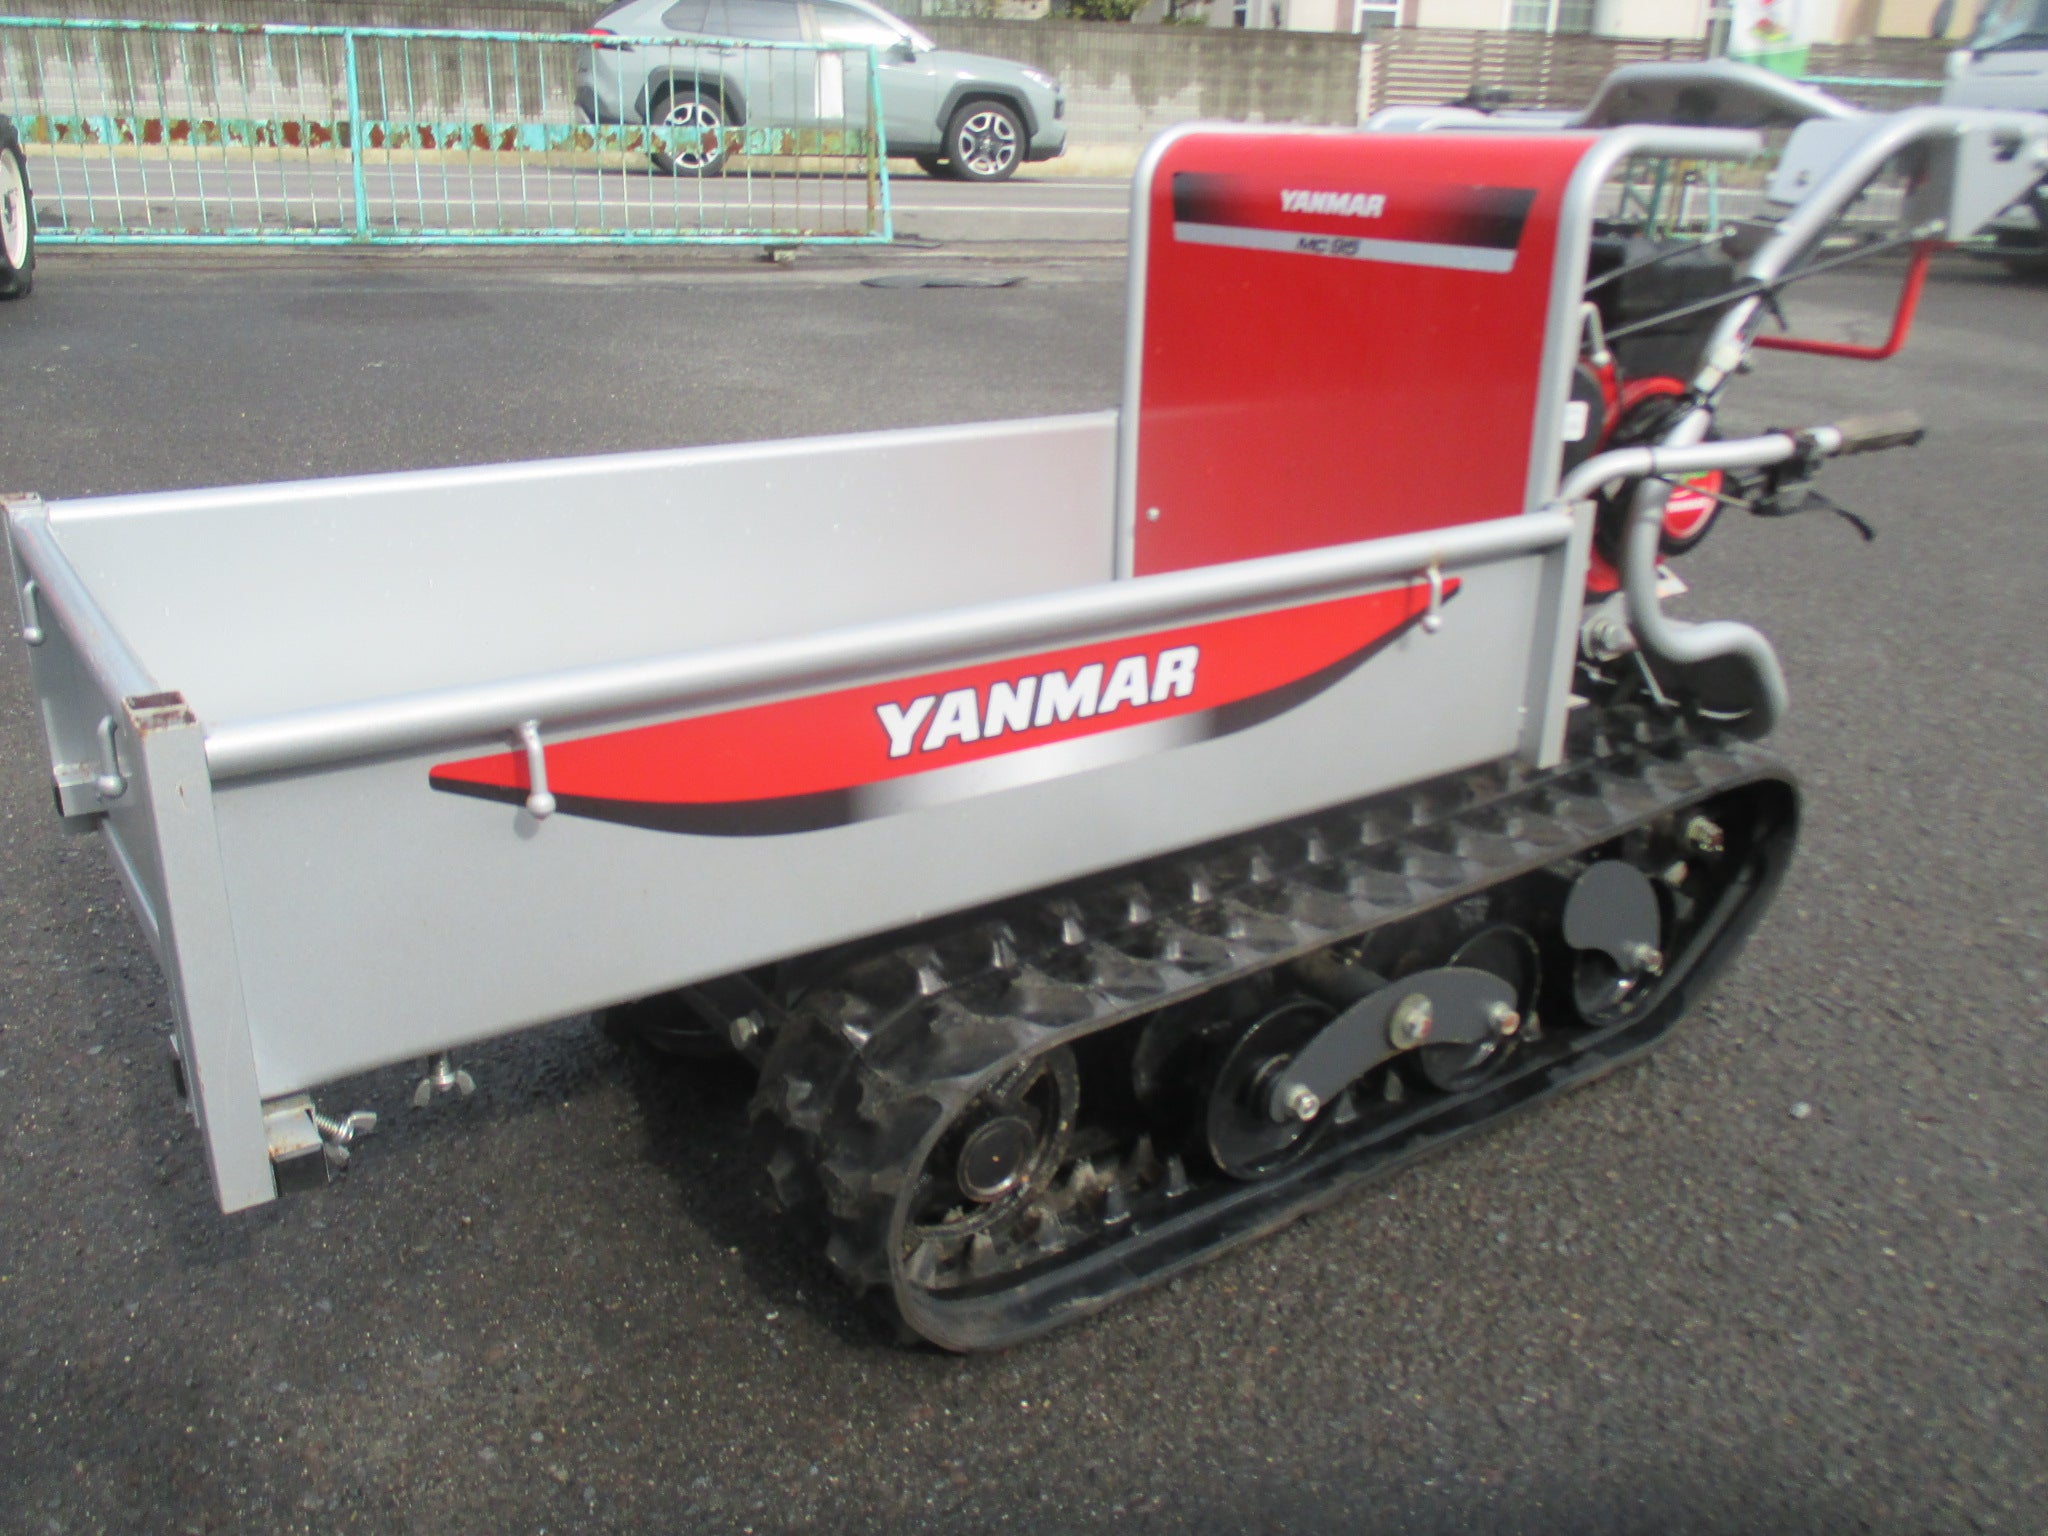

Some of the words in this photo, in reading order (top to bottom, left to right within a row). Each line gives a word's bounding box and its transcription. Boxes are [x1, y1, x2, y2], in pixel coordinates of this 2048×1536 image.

[1280, 189, 1386, 218] YANMAR
[1296, 237, 1328, 252] MC
[876, 645, 1200, 759] YANMAR
